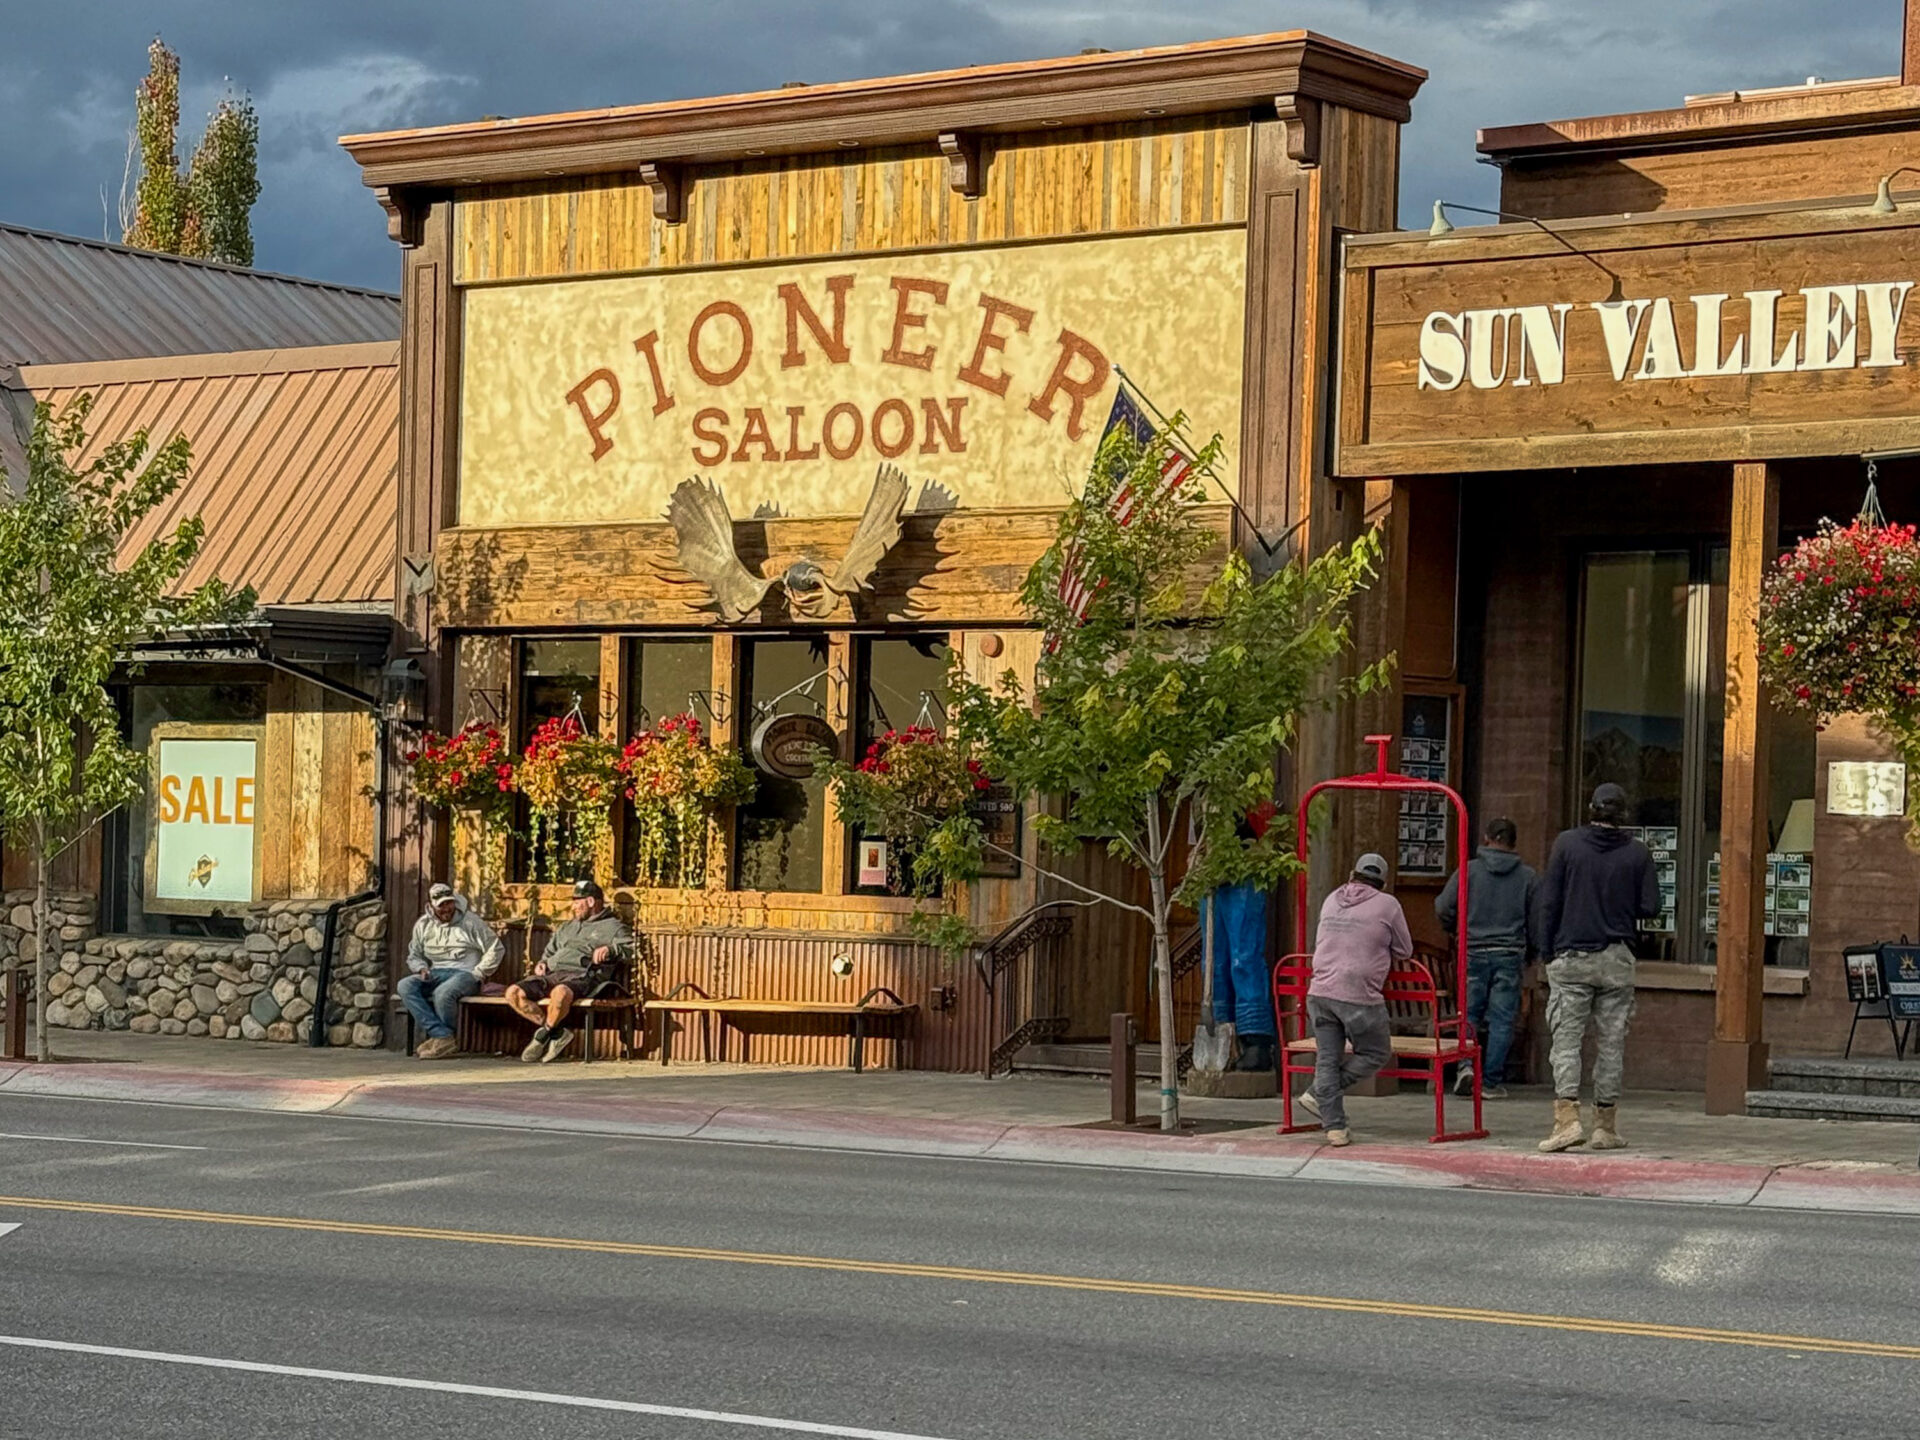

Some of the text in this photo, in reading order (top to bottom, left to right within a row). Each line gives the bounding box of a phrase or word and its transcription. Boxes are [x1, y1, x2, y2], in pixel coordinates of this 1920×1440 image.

[565, 273, 1111, 462] PIONEER
[1418, 281, 1915, 391] SUN VALLEY
[692, 397, 969, 467] SALOON
[160, 774, 255, 824] SALE
